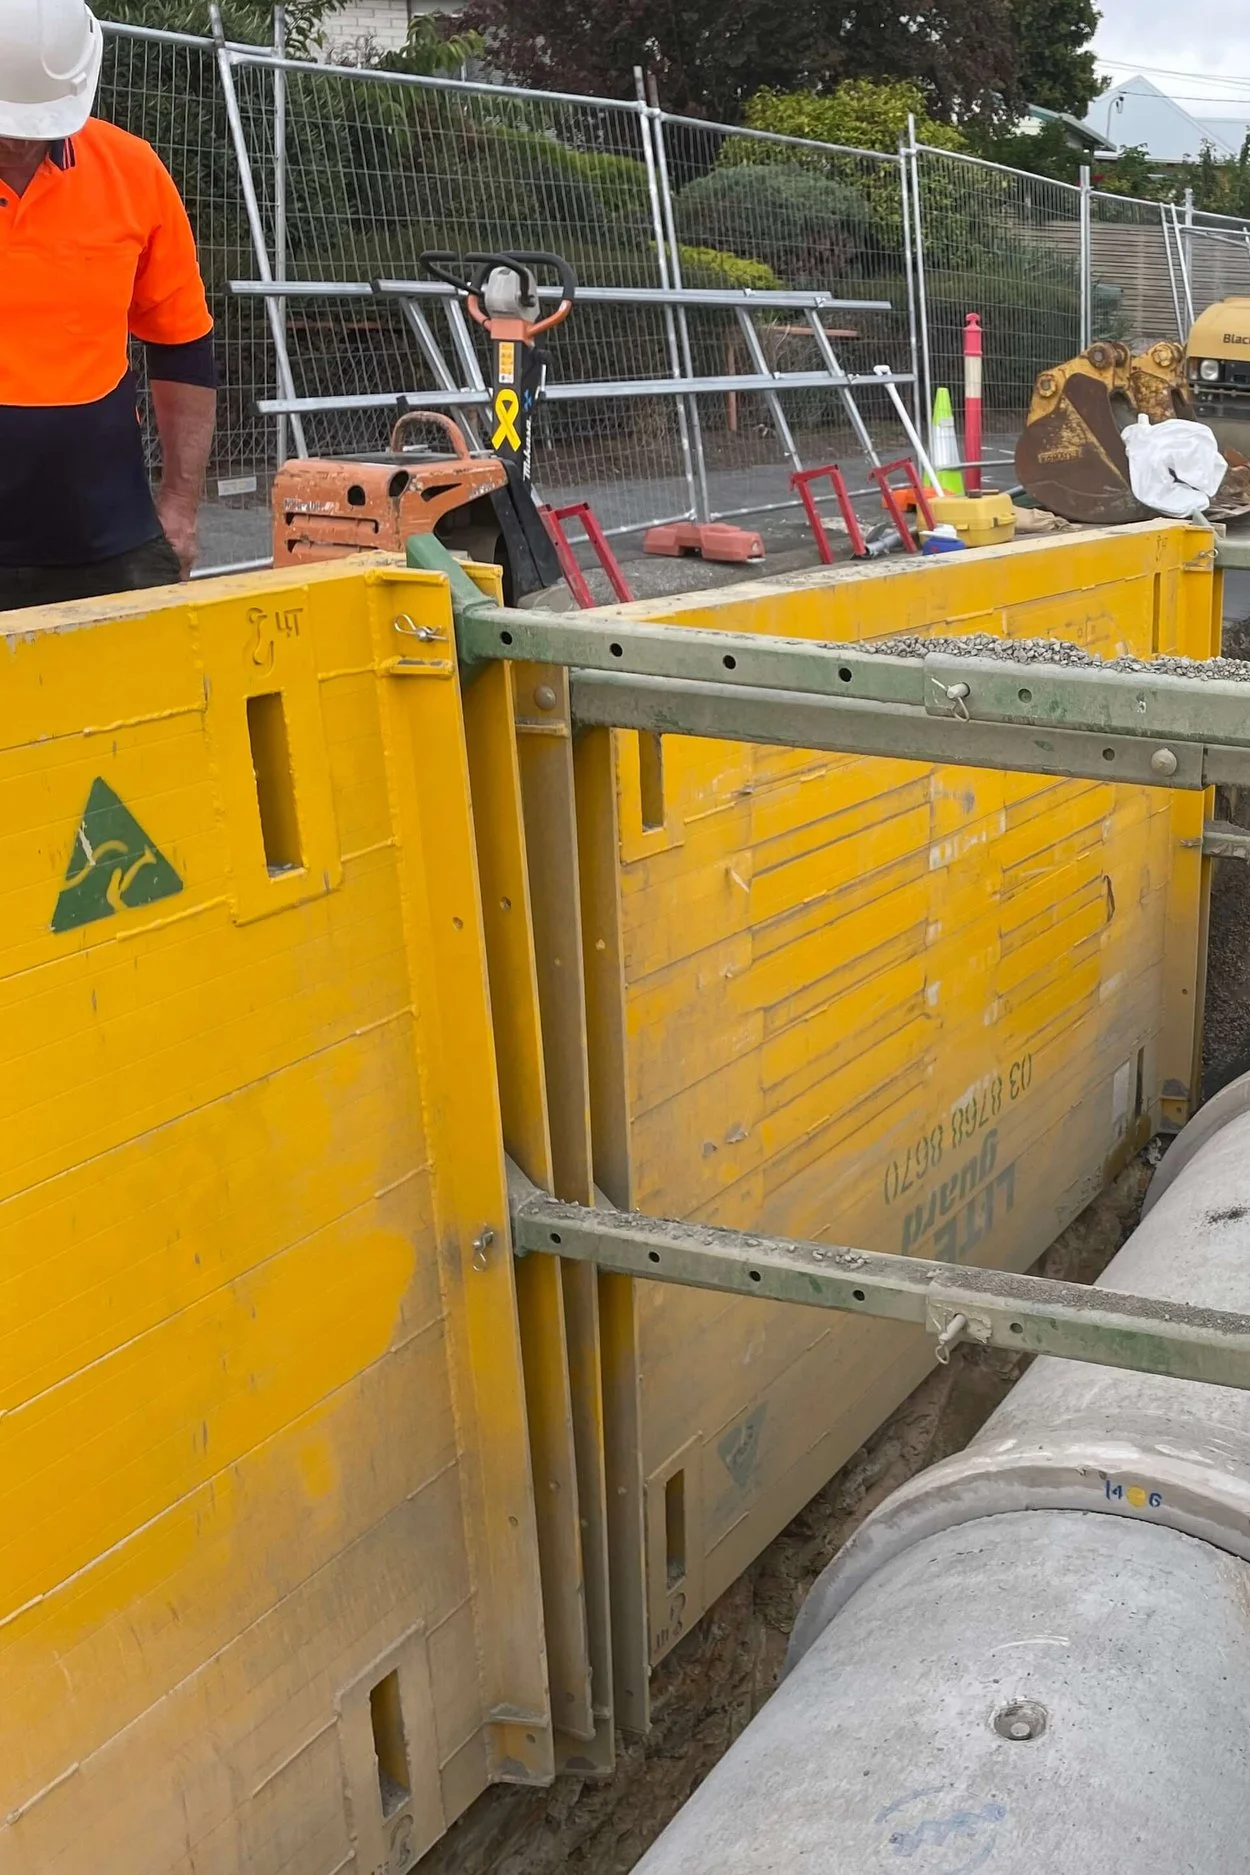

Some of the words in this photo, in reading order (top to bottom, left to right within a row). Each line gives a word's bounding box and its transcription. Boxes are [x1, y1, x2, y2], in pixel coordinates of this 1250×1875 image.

[951, 1076, 1002, 1149] 8768
[1010, 1052, 1032, 1100] 03
[883, 1124, 943, 1205] 8670
[901, 1127, 998, 1256] guard
[935, 1162, 1016, 1264] LITE
